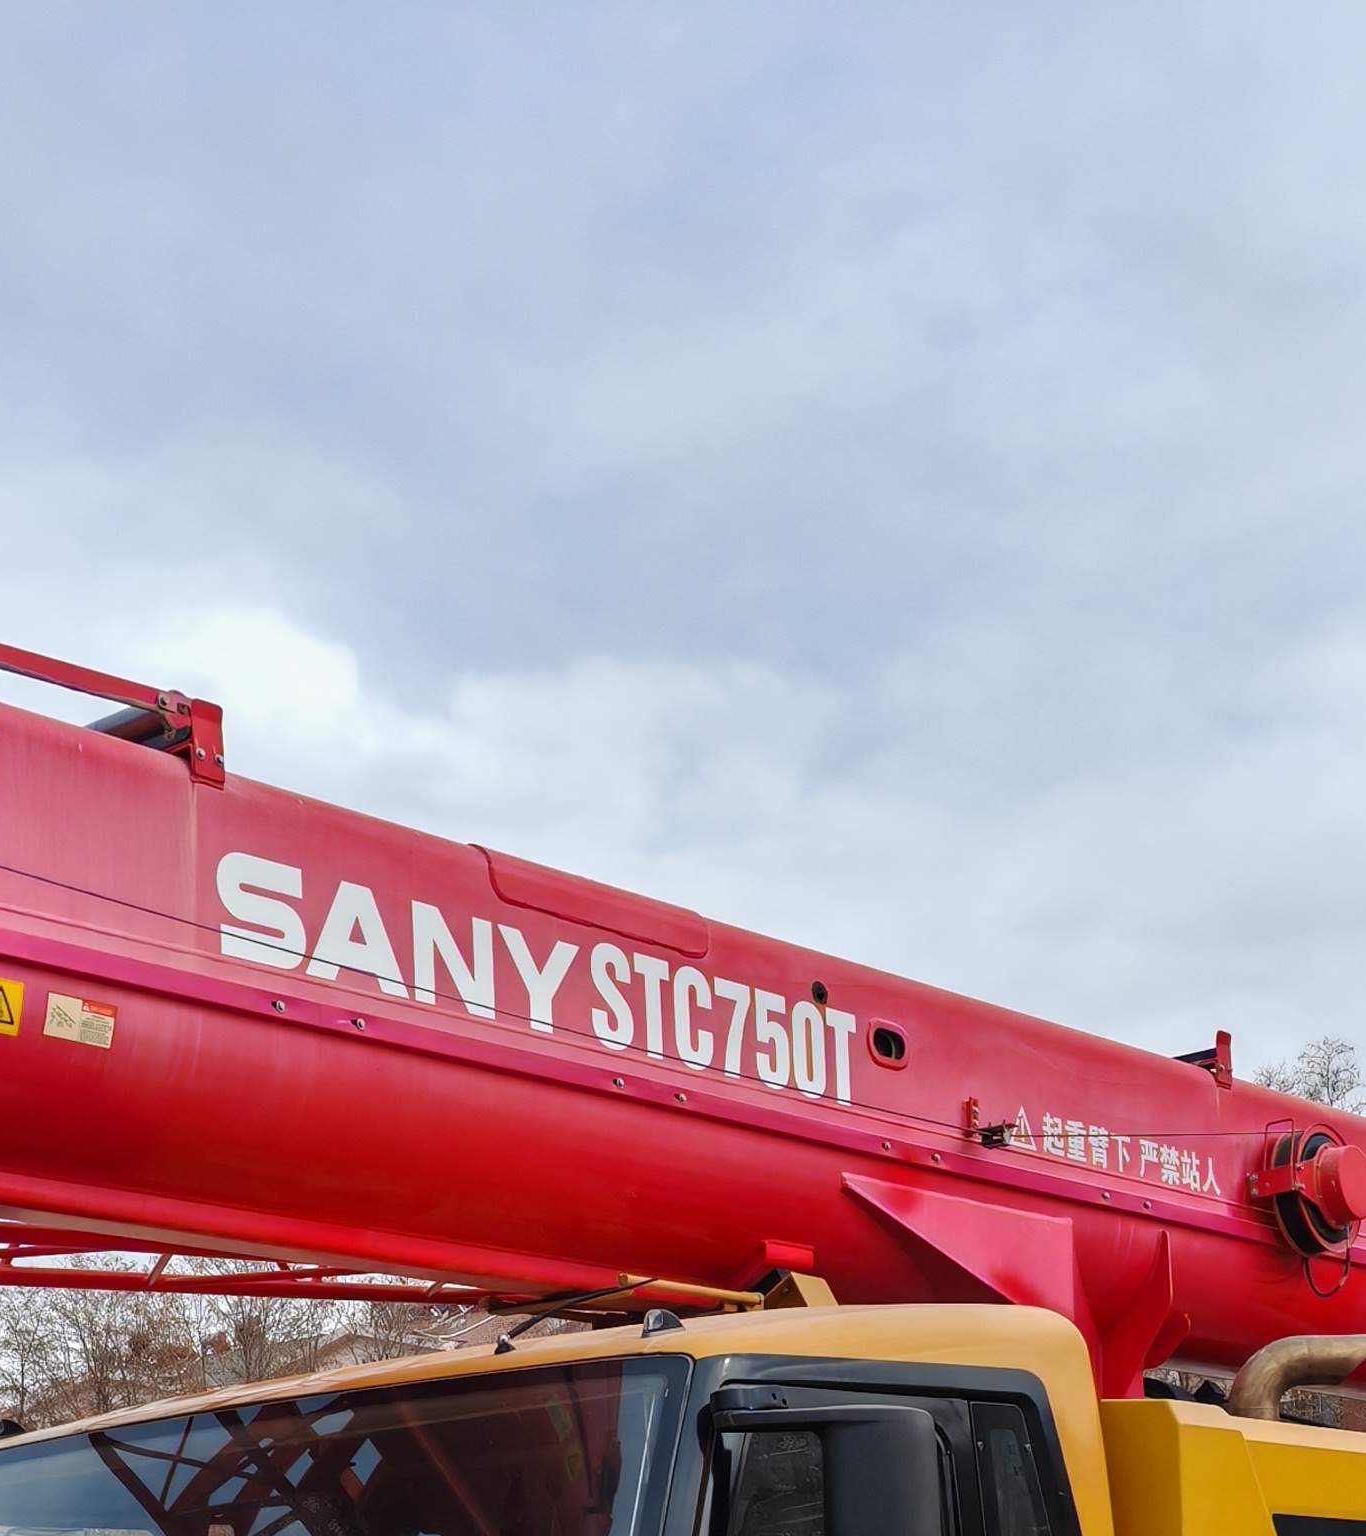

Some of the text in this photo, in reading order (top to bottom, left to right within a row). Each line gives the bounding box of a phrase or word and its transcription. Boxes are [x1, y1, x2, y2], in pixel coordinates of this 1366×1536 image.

[216, 851, 857, 1106] SANY STC750T
[1042, 1111, 1222, 1196] 起重臂下 严禁站人
